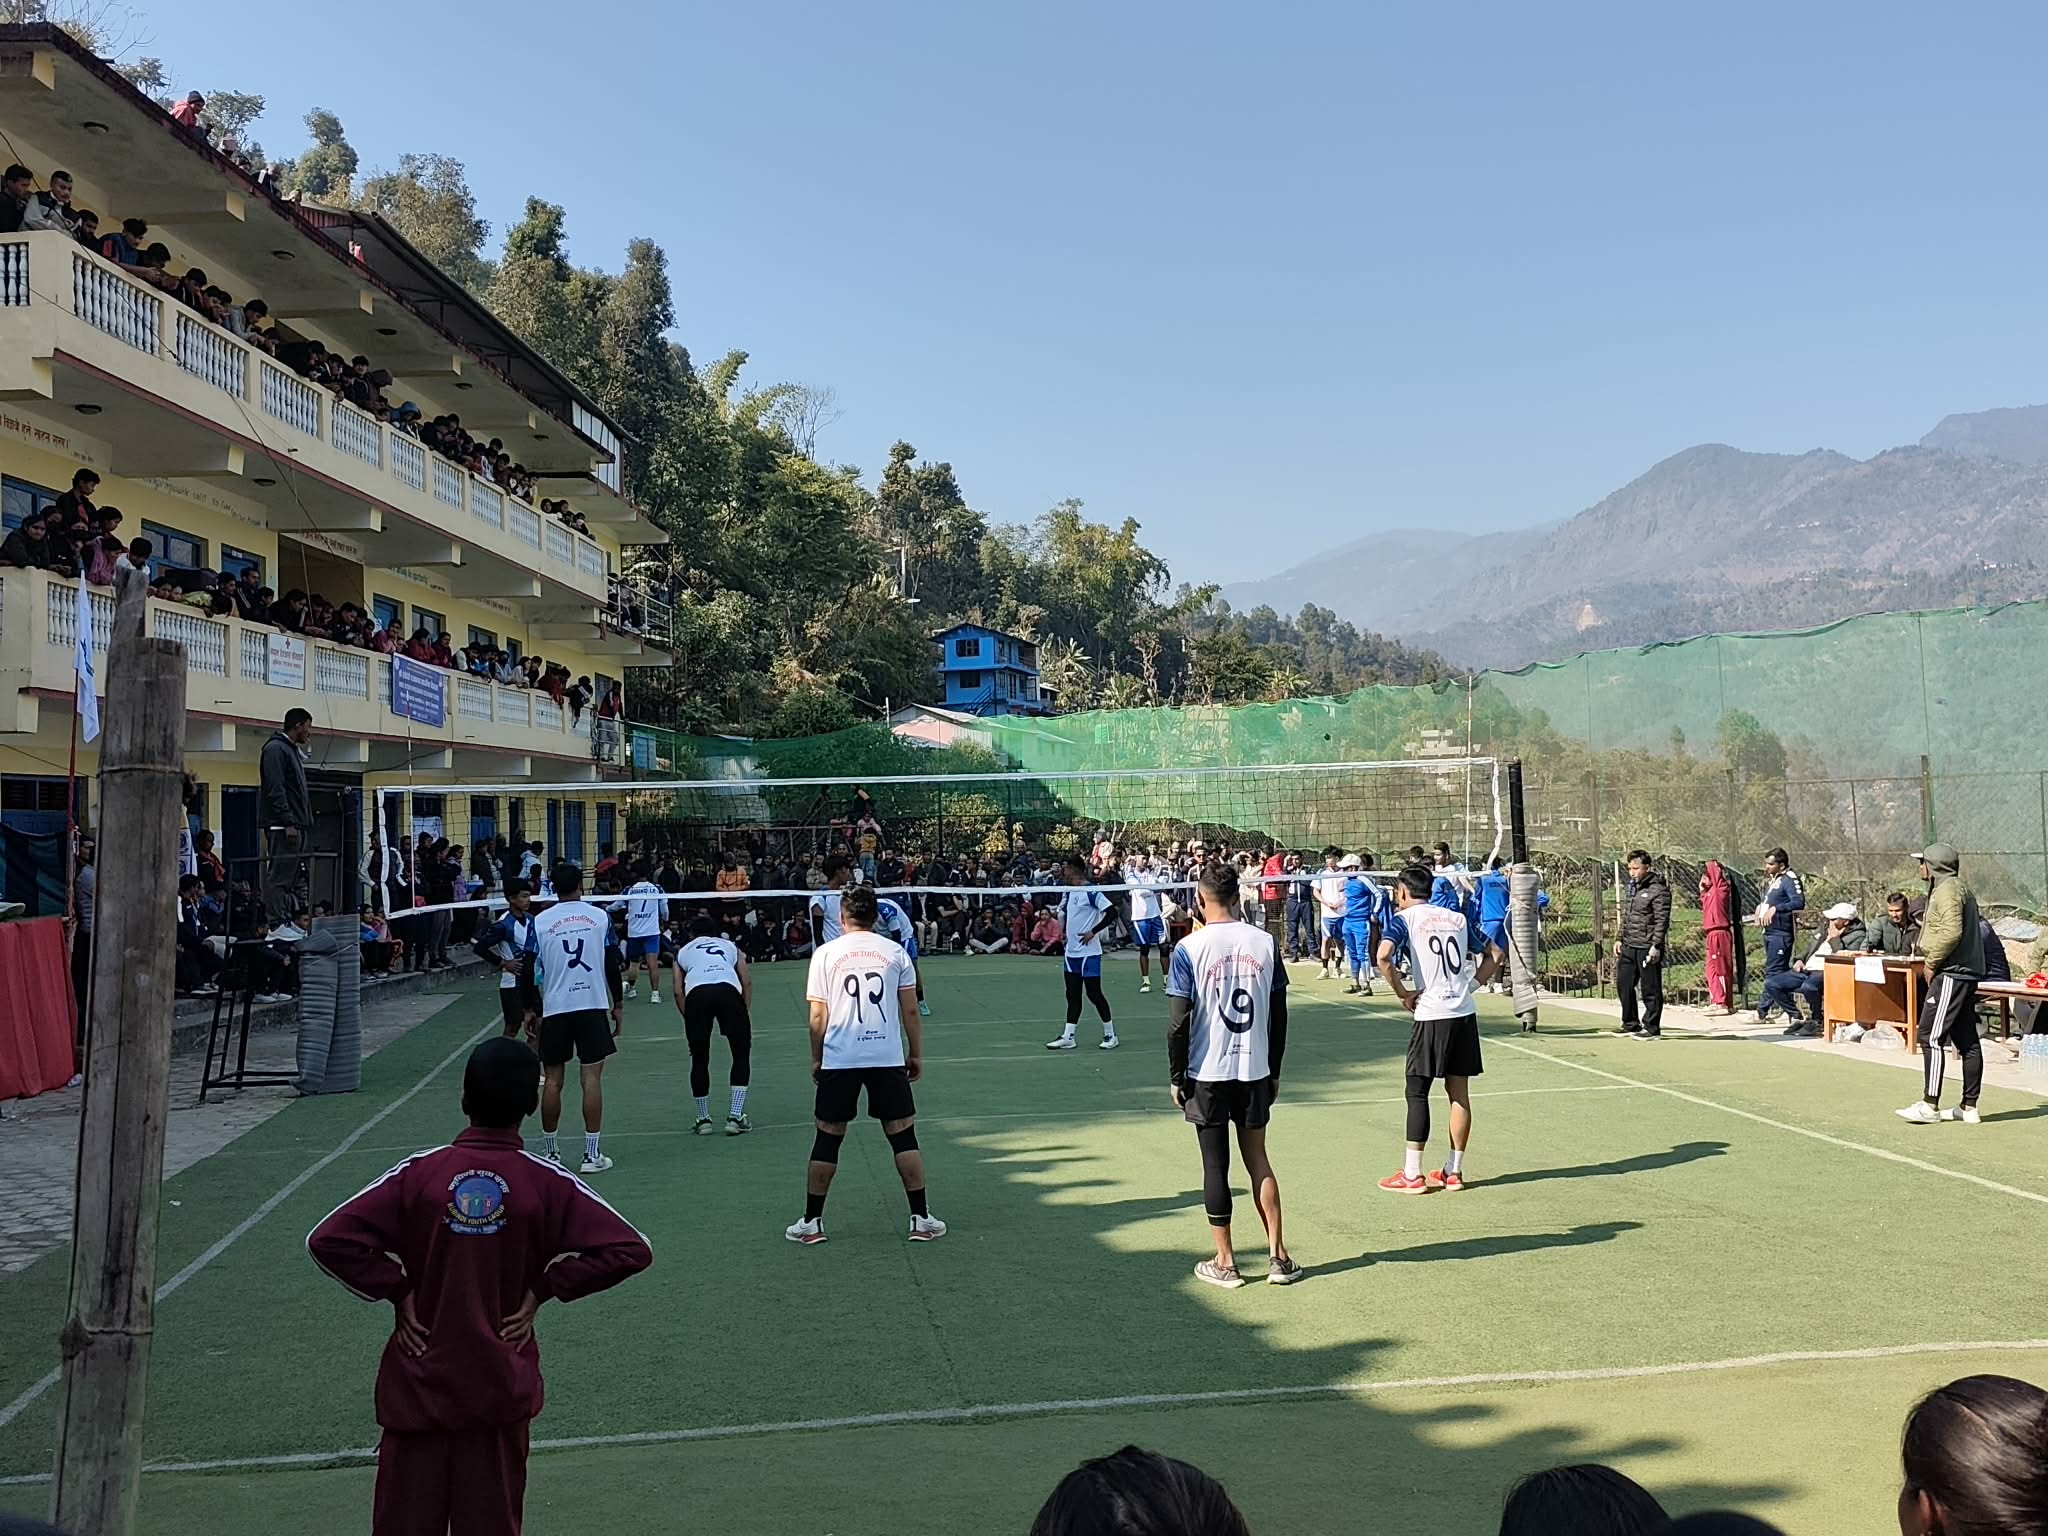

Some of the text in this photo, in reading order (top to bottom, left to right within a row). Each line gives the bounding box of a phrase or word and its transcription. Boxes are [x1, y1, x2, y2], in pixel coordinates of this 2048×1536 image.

[561, 937, 593, 973] ५
[1428, 934, 1462, 980] १०
[843, 971, 887, 1024] १२
[1215, 987, 1255, 1034] ७
